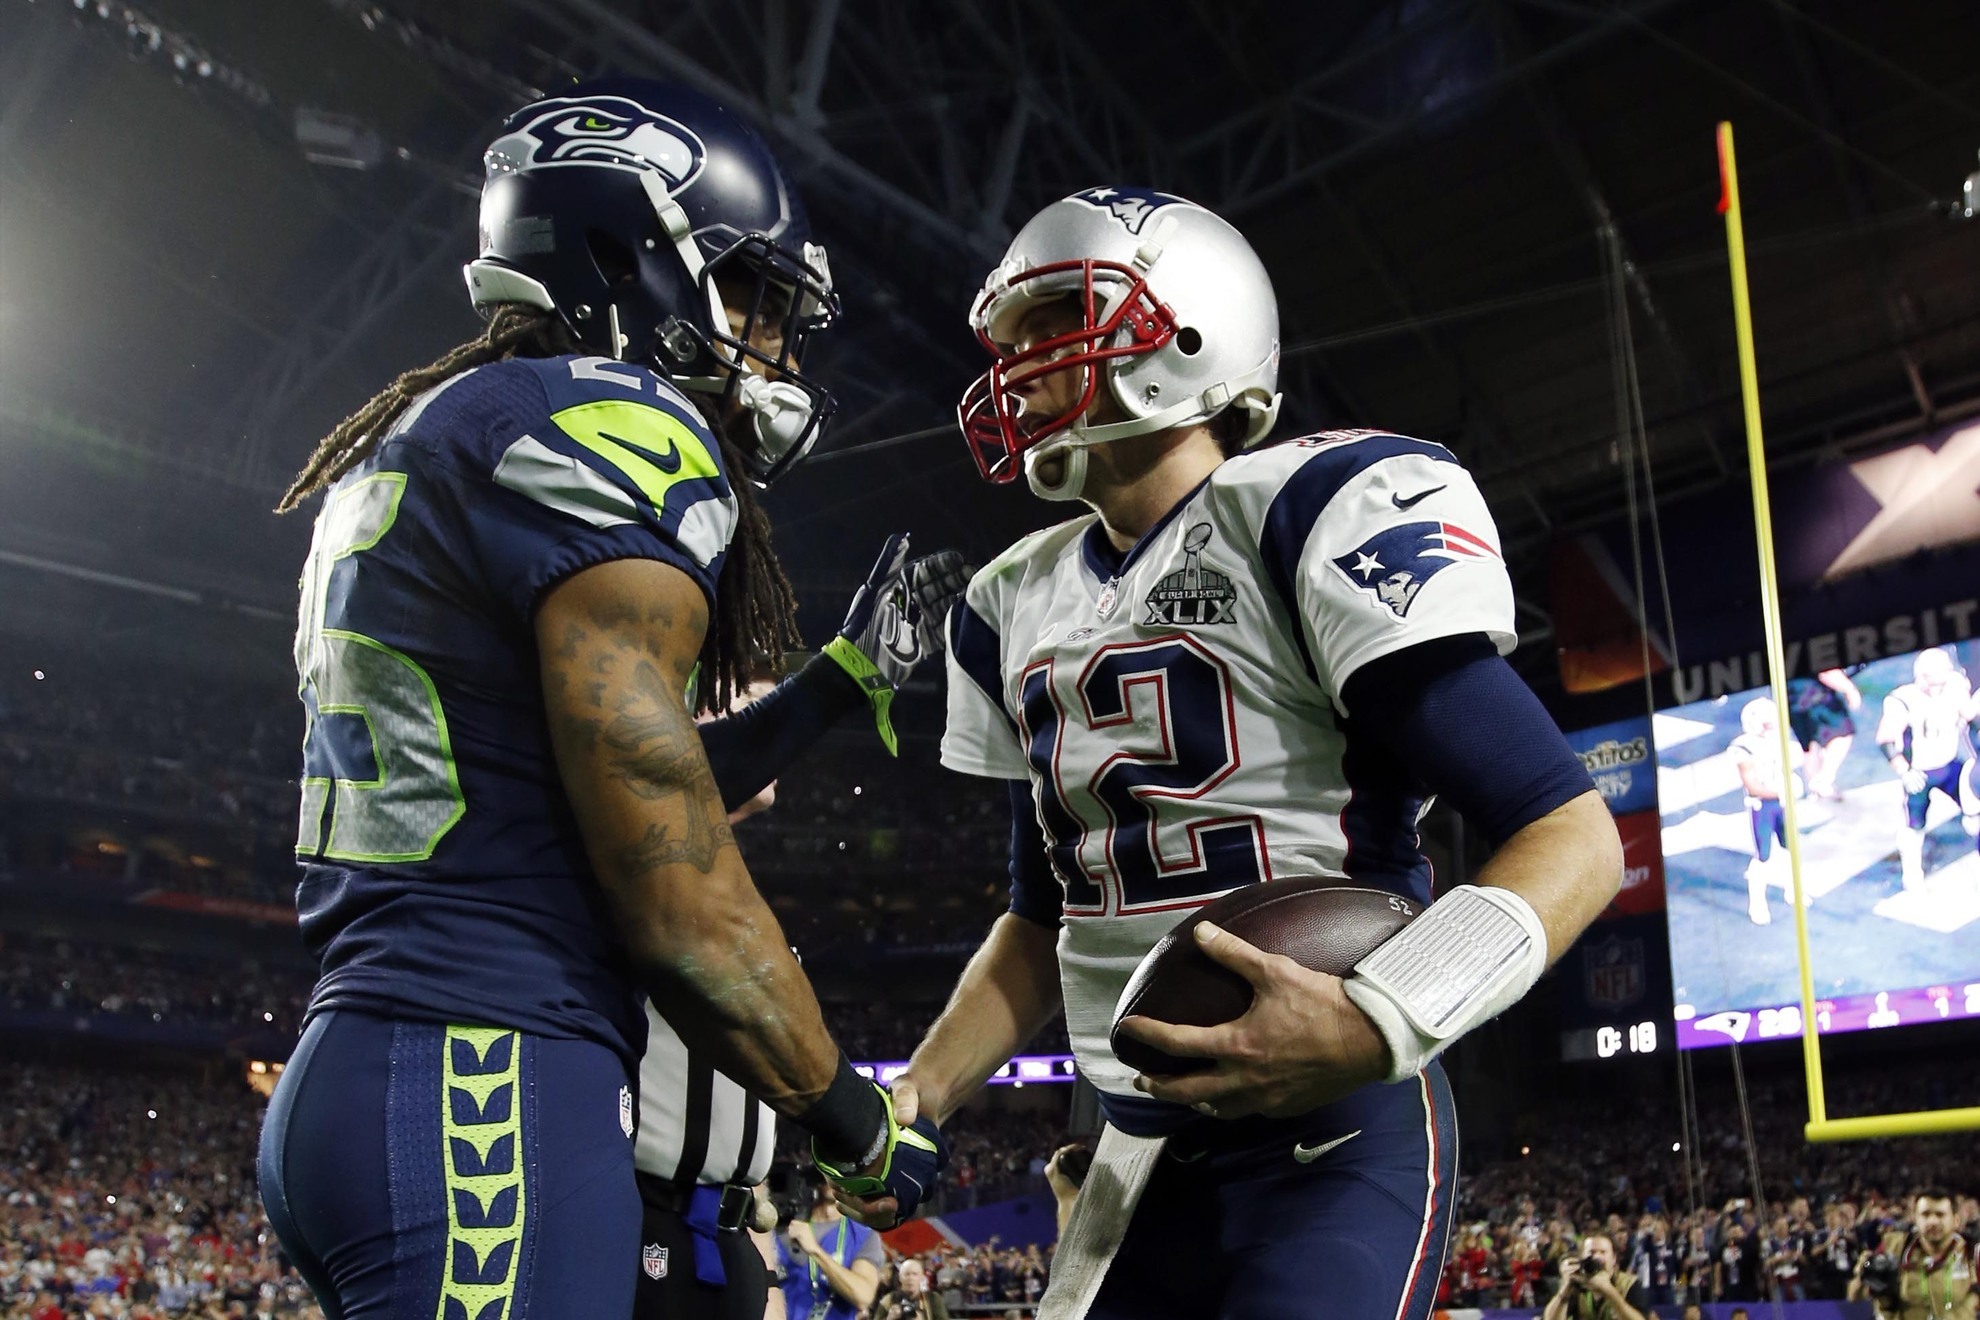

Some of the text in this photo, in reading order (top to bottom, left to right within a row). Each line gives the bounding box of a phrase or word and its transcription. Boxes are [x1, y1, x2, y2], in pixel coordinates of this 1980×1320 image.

[1144, 599, 1237, 625] XLIX
[1017, 633, 1271, 917] 12
[646, 1259, 664, 1274] NFL
